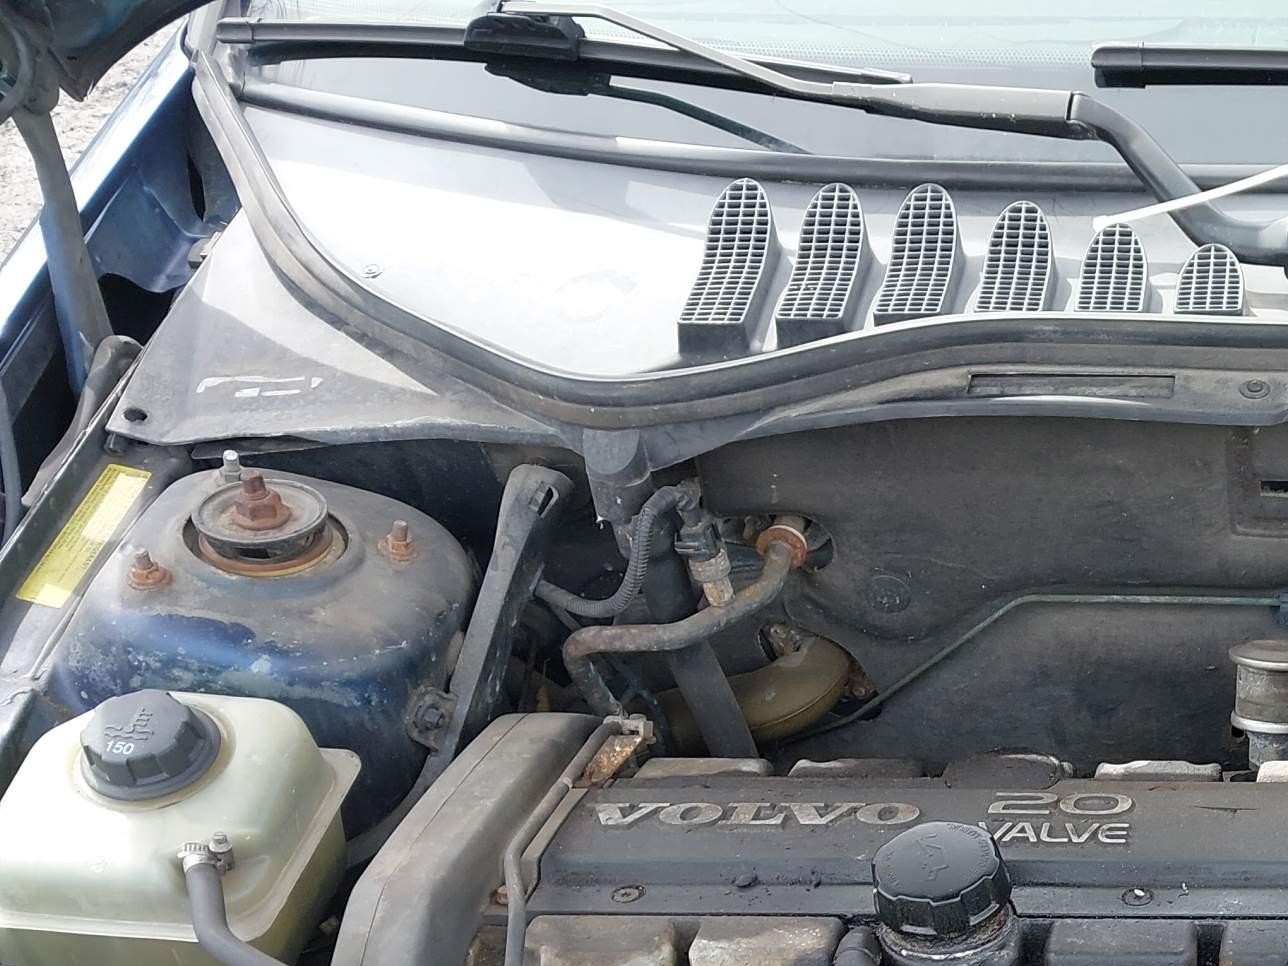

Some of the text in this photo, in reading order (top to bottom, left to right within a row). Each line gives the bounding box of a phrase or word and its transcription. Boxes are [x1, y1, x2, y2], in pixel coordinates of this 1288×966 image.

[106, 740, 134, 755] 150
[594, 801, 922, 827] VOLVO
[987, 792, 1134, 816] 20
[978, 821, 1130, 845] VALVE
